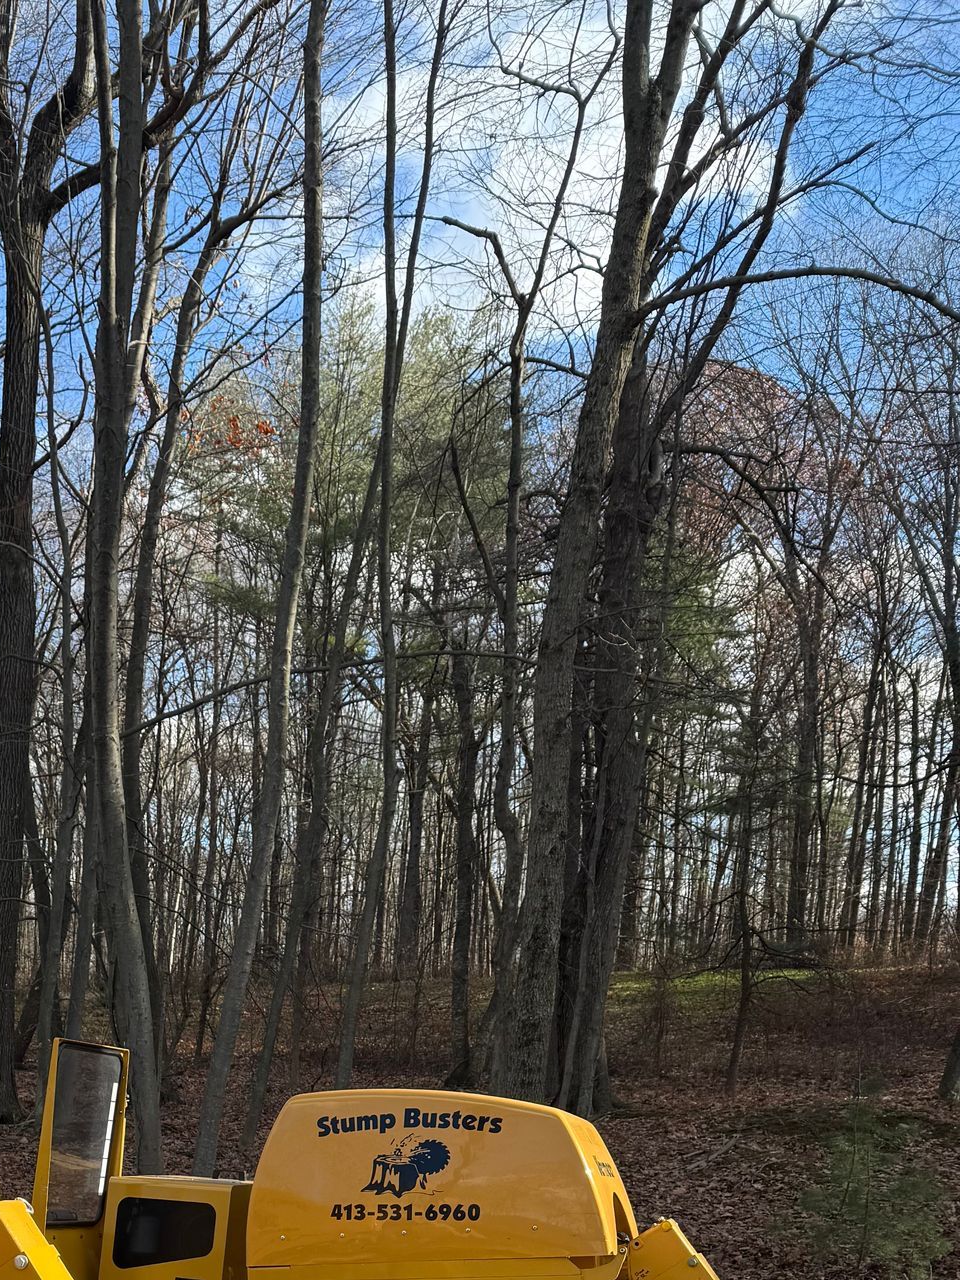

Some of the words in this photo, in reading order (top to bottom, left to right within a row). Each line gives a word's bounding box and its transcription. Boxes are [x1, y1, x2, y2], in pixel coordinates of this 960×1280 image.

[317, 1113, 396, 1137] Stump
[403, 1107, 503, 1133] Busters
[330, 1203, 481, 1222] 413-531-6960
